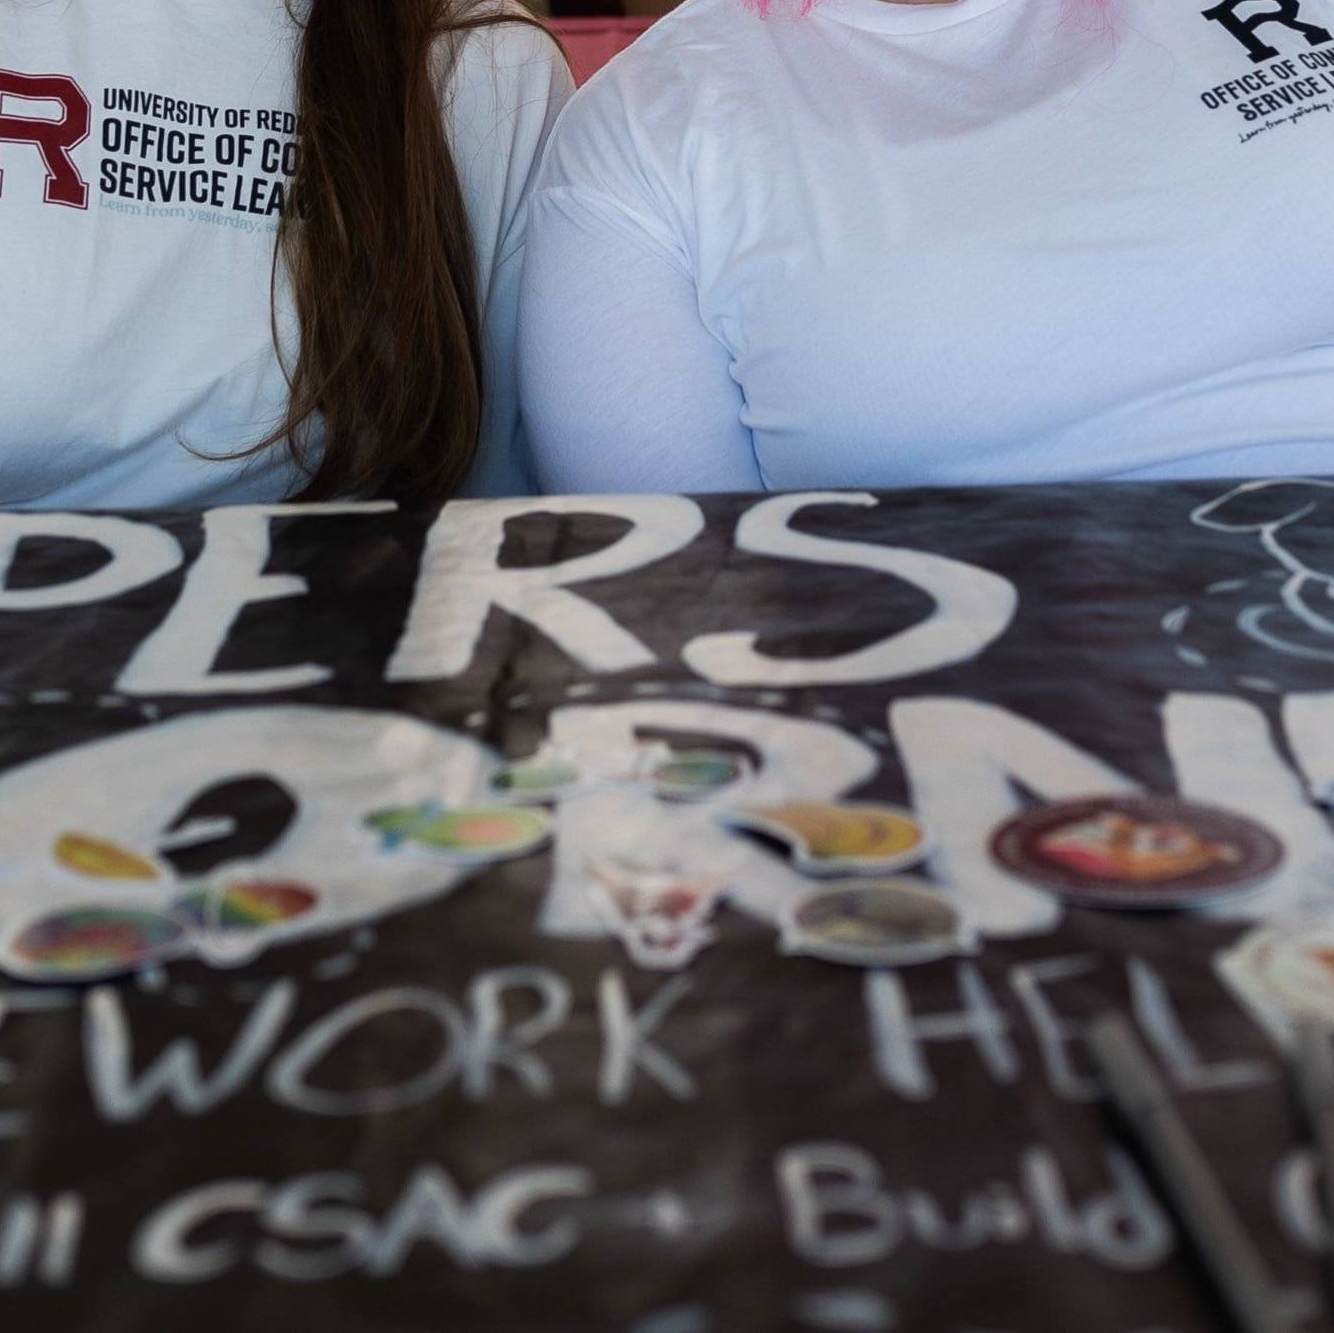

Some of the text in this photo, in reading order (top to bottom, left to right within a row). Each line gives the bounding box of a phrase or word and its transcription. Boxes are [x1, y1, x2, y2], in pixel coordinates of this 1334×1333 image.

[103, 87, 297, 135] UNIVERSITY OF RED
[1200, 68, 1274, 111] OFFICE
[1269, 59, 1299, 80] OF
[1236, 76, 1327, 122] SERVICE
[102, 117, 301, 177] OFFICE OF CO
[98, 193, 142, 214] Learn
[145, 204, 186, 218] from
[99, 158, 287, 217] SERVICE LEA
[864, 953, 1275, 1100] HEL
[132, 1164, 595, 1284] CSAC
[772, 1136, 1174, 1271] Build
